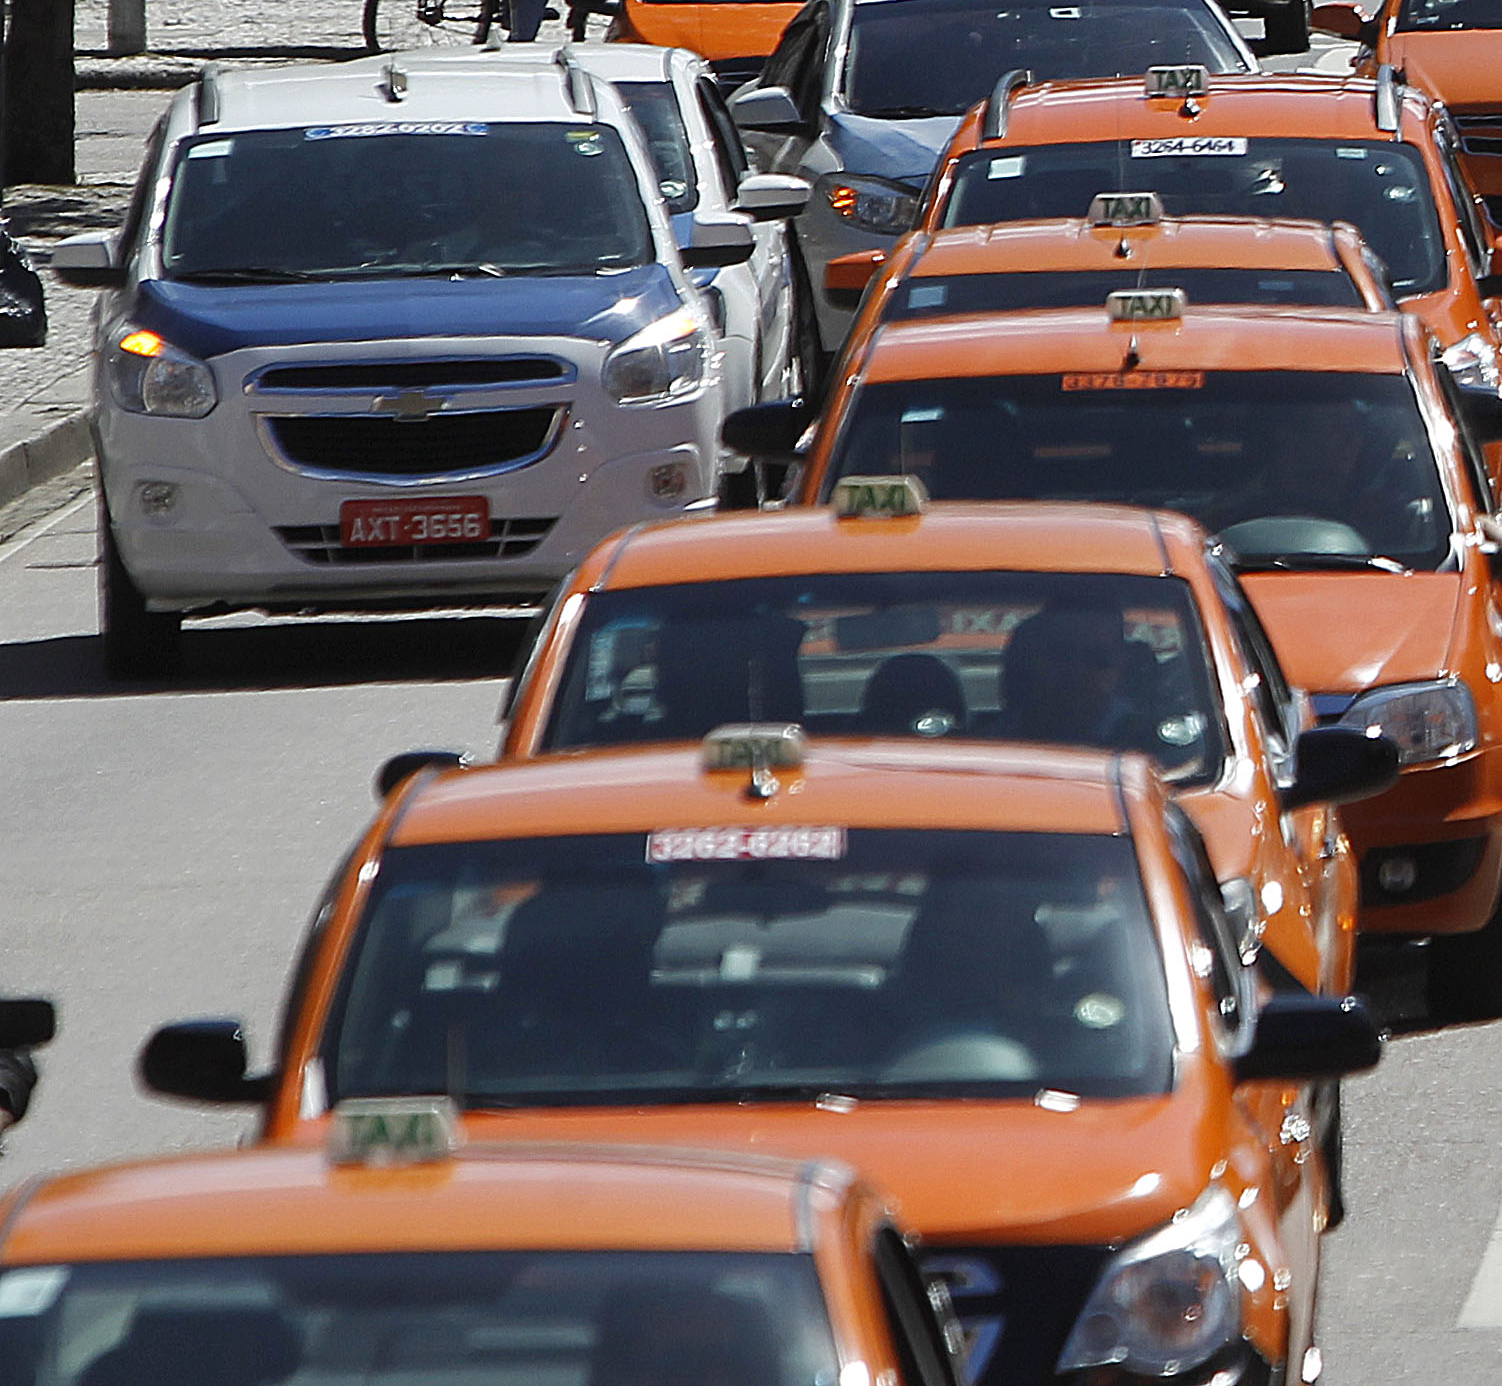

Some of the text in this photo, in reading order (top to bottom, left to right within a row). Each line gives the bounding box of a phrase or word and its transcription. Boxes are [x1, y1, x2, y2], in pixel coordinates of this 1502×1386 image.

[1152, 69, 1202, 90] TAXI
[1102, 196, 1151, 219] TAXI
[1114, 296, 1173, 316] TAXI
[847, 484, 907, 513] TAXI
[346, 1114, 435, 1149] TAXI
